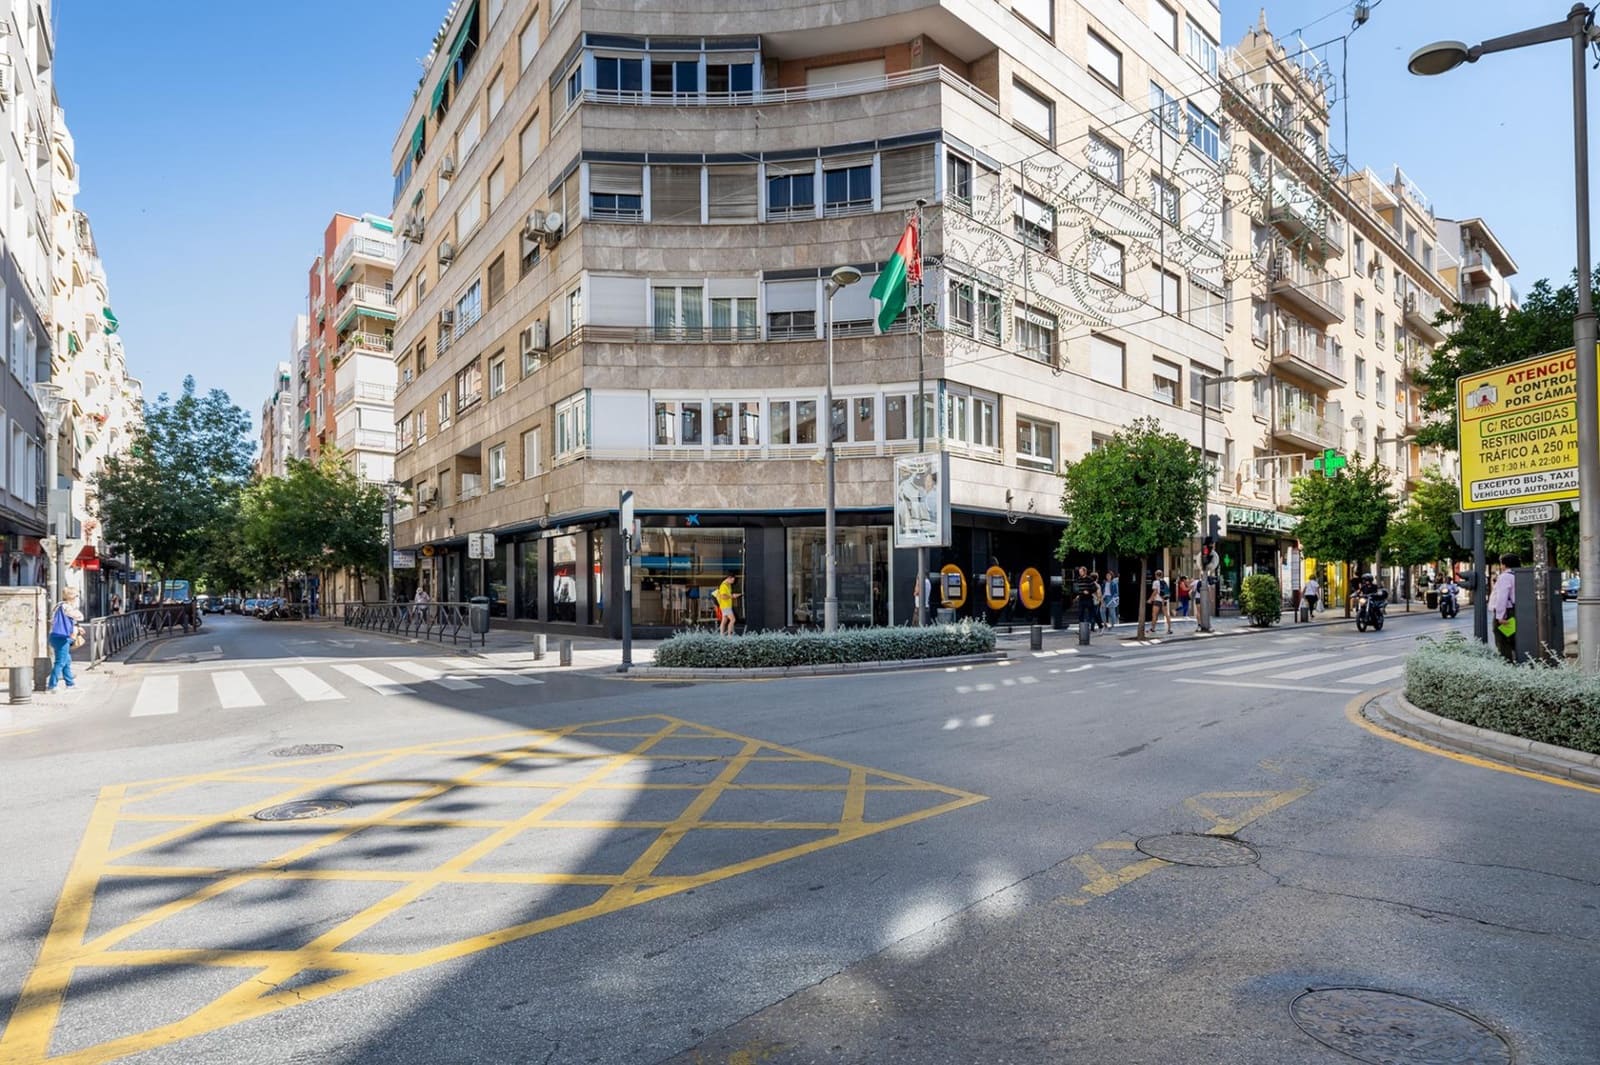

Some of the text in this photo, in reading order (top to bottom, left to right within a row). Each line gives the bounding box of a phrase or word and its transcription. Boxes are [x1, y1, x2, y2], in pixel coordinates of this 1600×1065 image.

[1514, 373, 1576, 394] CONTROL
[1505, 395, 1530, 408] POR
[1487, 407, 1568, 433] C/ RECOGIDAS
[1481, 424, 1576, 450] RESTRINGIDA AL
[1479, 440, 1578, 463] TRÁFICO A 250 m
[1489, 455, 1572, 473] DE 7:30 H. A 22:00 H.
[1475, 481, 1579, 499] VEHÍCULOS AUTORIZAD
[1478, 479, 1520, 490] EXCEPTO
[1550, 471, 1574, 480] TAXI
[1520, 513, 1548, 521] HOTELES
